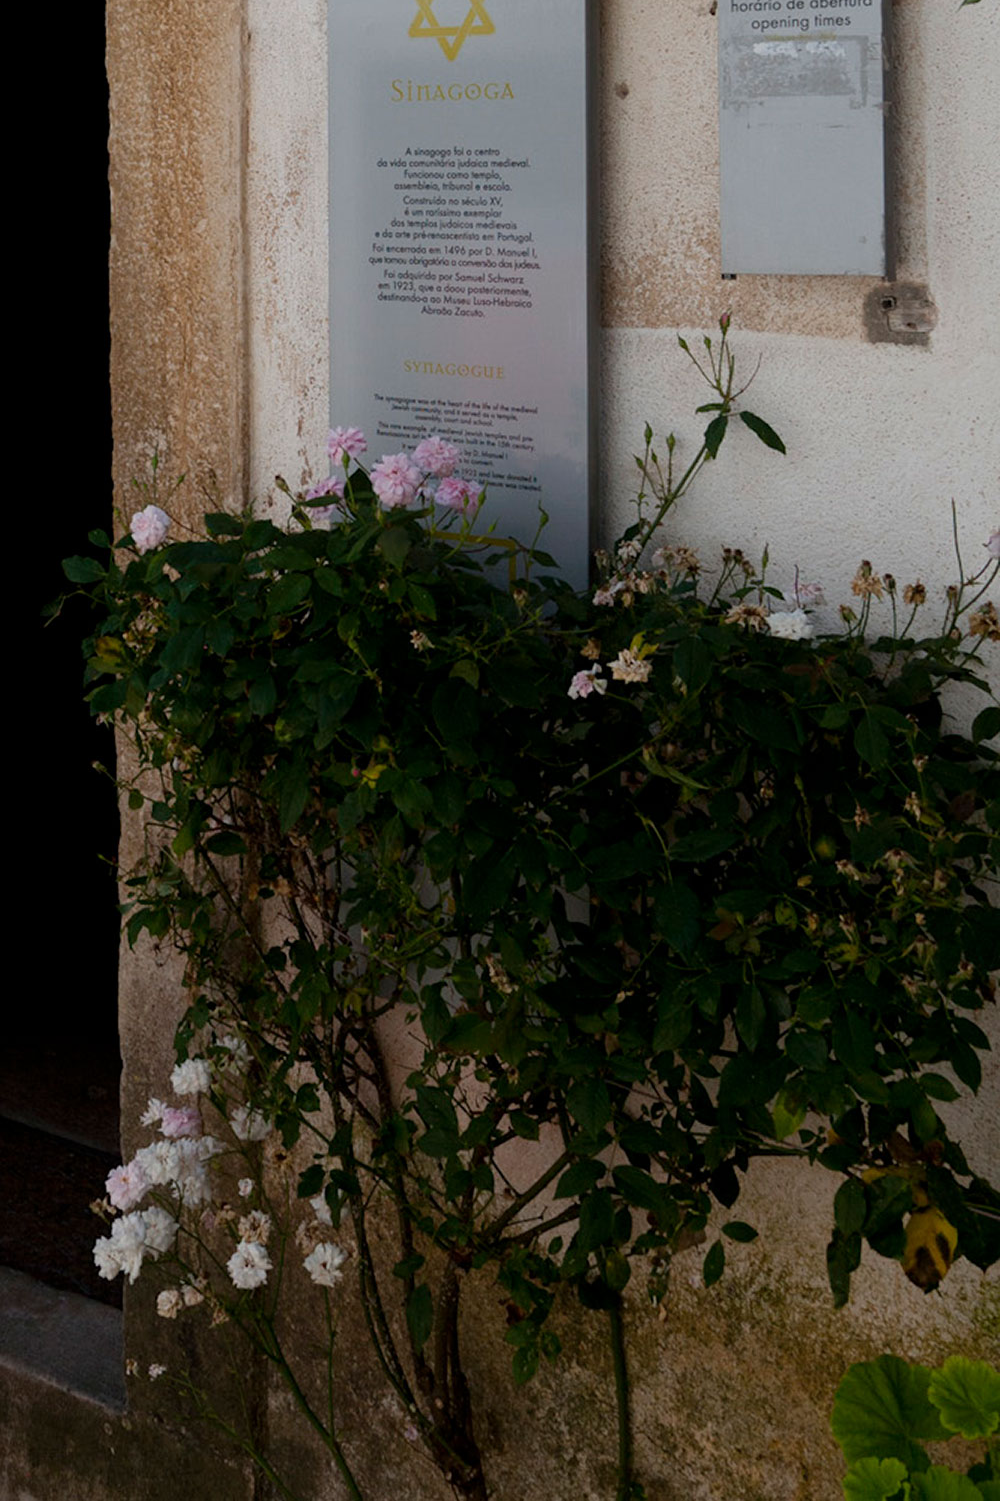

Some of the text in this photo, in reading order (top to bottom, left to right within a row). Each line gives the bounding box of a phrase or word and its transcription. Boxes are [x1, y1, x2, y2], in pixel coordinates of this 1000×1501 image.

[751, 13, 851, 32] opening times
[391, 79, 515, 102] SINAGOGA
[405, 147, 412, 155] A
[414, 147, 451, 158] sinagoga
[454, 146, 464, 156] foi
[474, 147, 500, 156] centro
[376, 158, 531, 170] da vida comunitária judaica medieval.
[403, 169, 445, 179] Funcionou
[471, 170, 502, 181] templo,
[394, 180, 441, 192] assembleia,
[442, 181, 473, 190] tribunal
[482, 181, 512, 191] escola.
[461, 196, 488, 206] século
[489, 196, 503, 207] XV,
[404, 207, 409, 216] é
[425, 207, 461, 217] raríssimo
[463, 208, 502, 220] exemplar
[390, 217, 517, 231] dos templos judaicos medievais
[382, 228, 393, 238] da
[497, 232, 534, 244] Portugal.
[372, 243, 384, 252] Foi
[386, 244, 427, 254] encerrada
[444, 245, 466, 255] 1496
[468, 248, 483, 257] por
[485, 247, 495, 256] D.
[497, 247, 530, 257] Manuel
[369, 257, 382, 266] que
[409, 255, 449, 268] obrigatória
[458, 258, 497, 268] conversão
[498, 258, 513, 268] dos
[514, 259, 541, 271] judeus.
[384, 269, 524, 284] Foi por Samuel Schwarz
[393, 281, 416, 292] 1923,
[418, 284, 434, 293] que
[444, 284, 465, 293] doou
[467, 286, 532, 297] posteriormente,
[377, 291, 533, 308] destinando-a ao Museu Luso-Hebraico
[420, 305, 486, 318] Abraão Zacuto.
[403, 360, 505, 380] SYNAGOGUE
